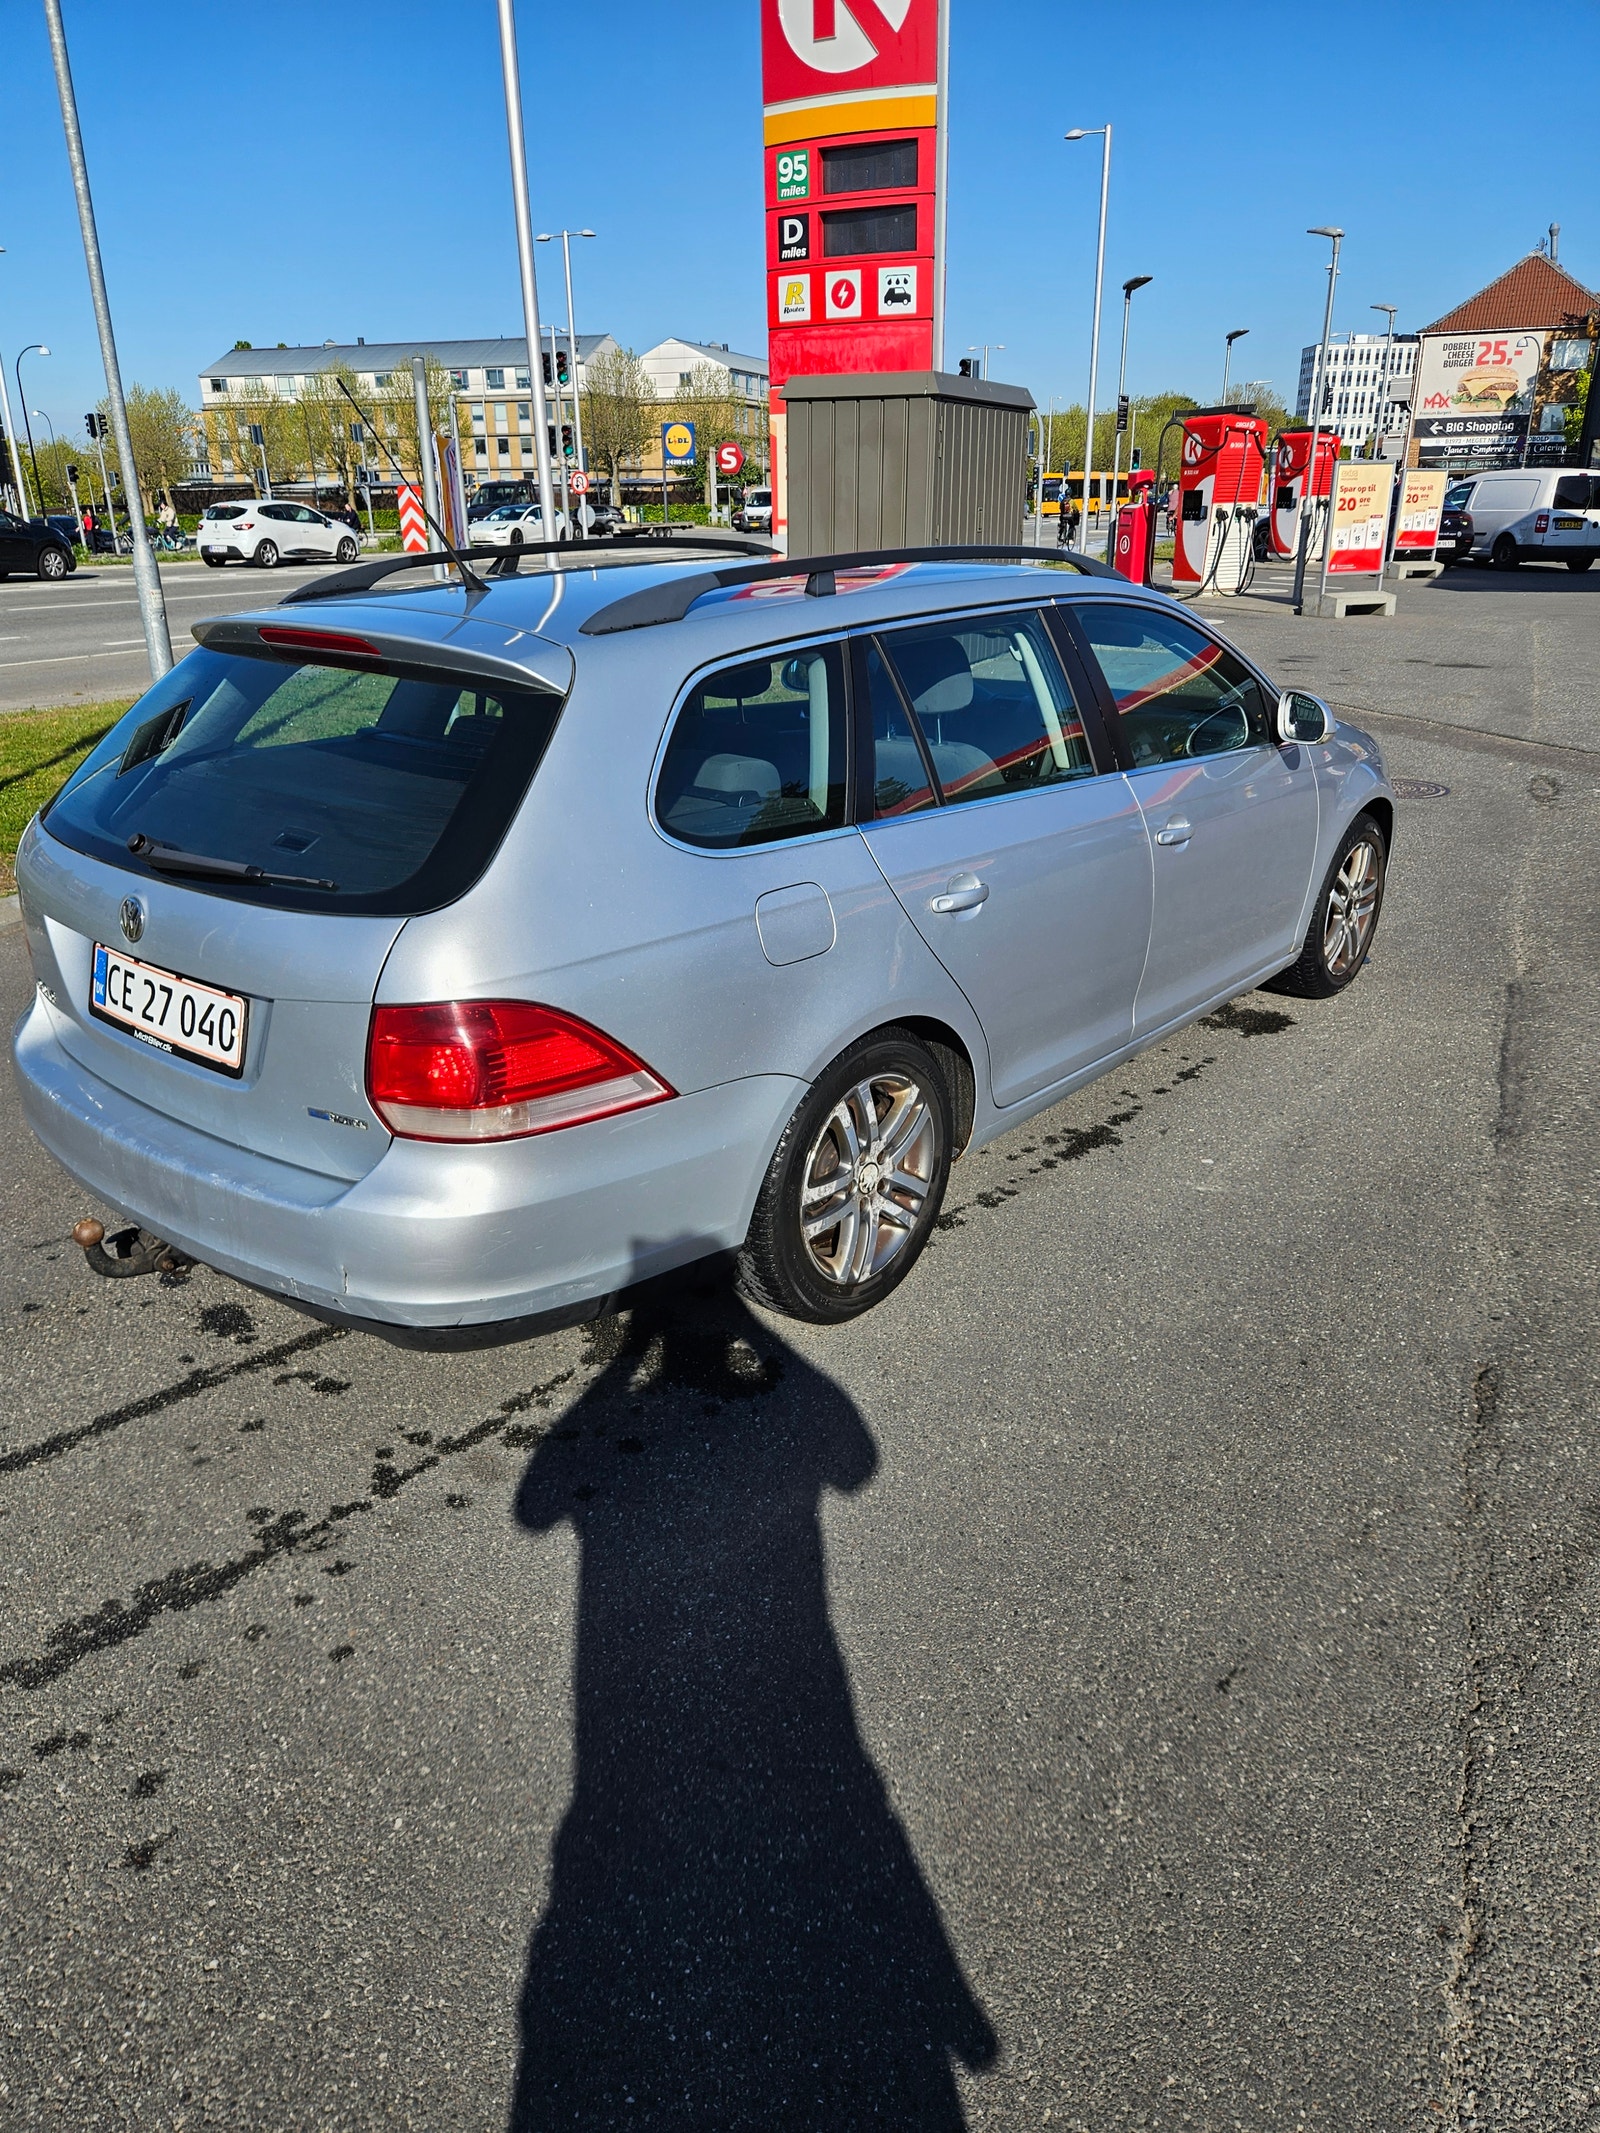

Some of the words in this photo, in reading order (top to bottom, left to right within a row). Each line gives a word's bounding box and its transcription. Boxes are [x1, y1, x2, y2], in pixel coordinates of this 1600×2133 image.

[778, 154, 808, 184] 95
[781, 184, 807, 198] miles
[783, 218, 804, 245] D
[781, 246, 807, 259] miles
[1442, 341, 1477, 352] DOBBELT
[1447, 350, 1475, 360] CHEESE
[1443, 359, 1474, 368] BURGER
[1423, 392, 1451, 409] MAX
[1446, 422, 1464, 433] BIG
[1465, 420, 1515, 434] Shopping
[721, 447, 737, 469] S
[1339, 485, 1356, 494] Spar
[1357, 486, 1367, 494] op
[1368, 484, 1376, 492] til
[1337, 497, 1357, 511] 20
[1405, 494, 1419, 504] 20
[95, 981, 104, 997] DK
[108, 964, 135, 1013] CE
[141, 978, 173, 1026] 27
[180, 994, 236, 1052] 040
